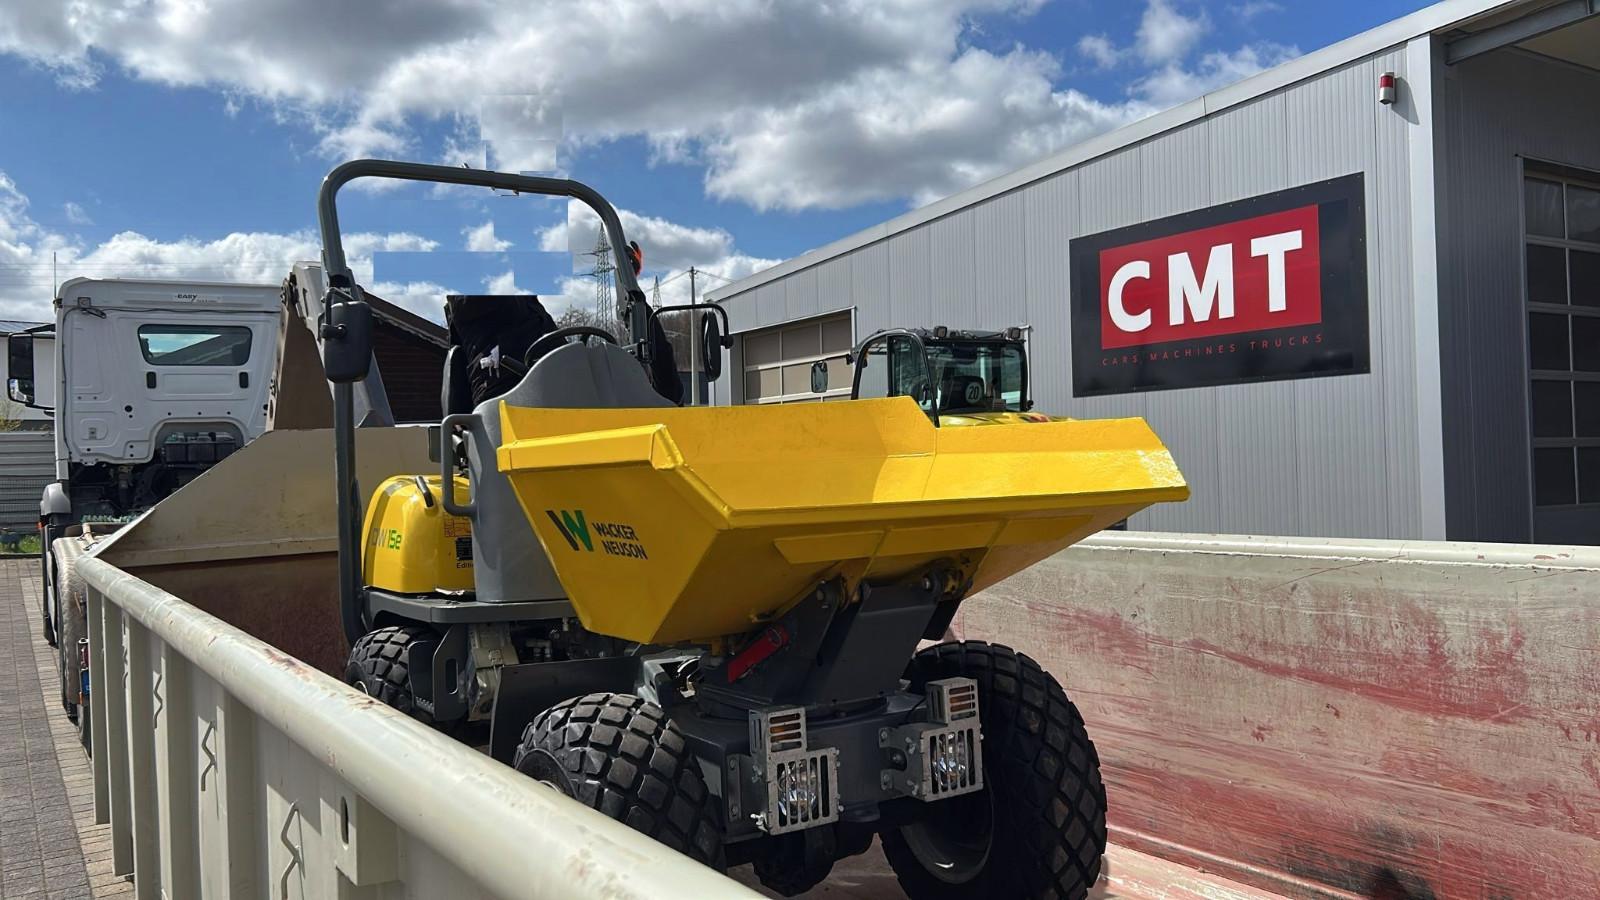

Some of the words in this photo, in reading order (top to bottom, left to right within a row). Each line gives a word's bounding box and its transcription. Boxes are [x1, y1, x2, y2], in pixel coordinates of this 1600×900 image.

[1107, 229, 1303, 333] CMT
[1102, 354, 1138, 366] CARS
[1150, 344, 1237, 361] MACHINES
[1250, 334, 1323, 350] TRUCKS
[967, 385, 980, 400] 20
[591, 521, 639, 541] WACKER
[601, 539, 648, 560] NEUSON
